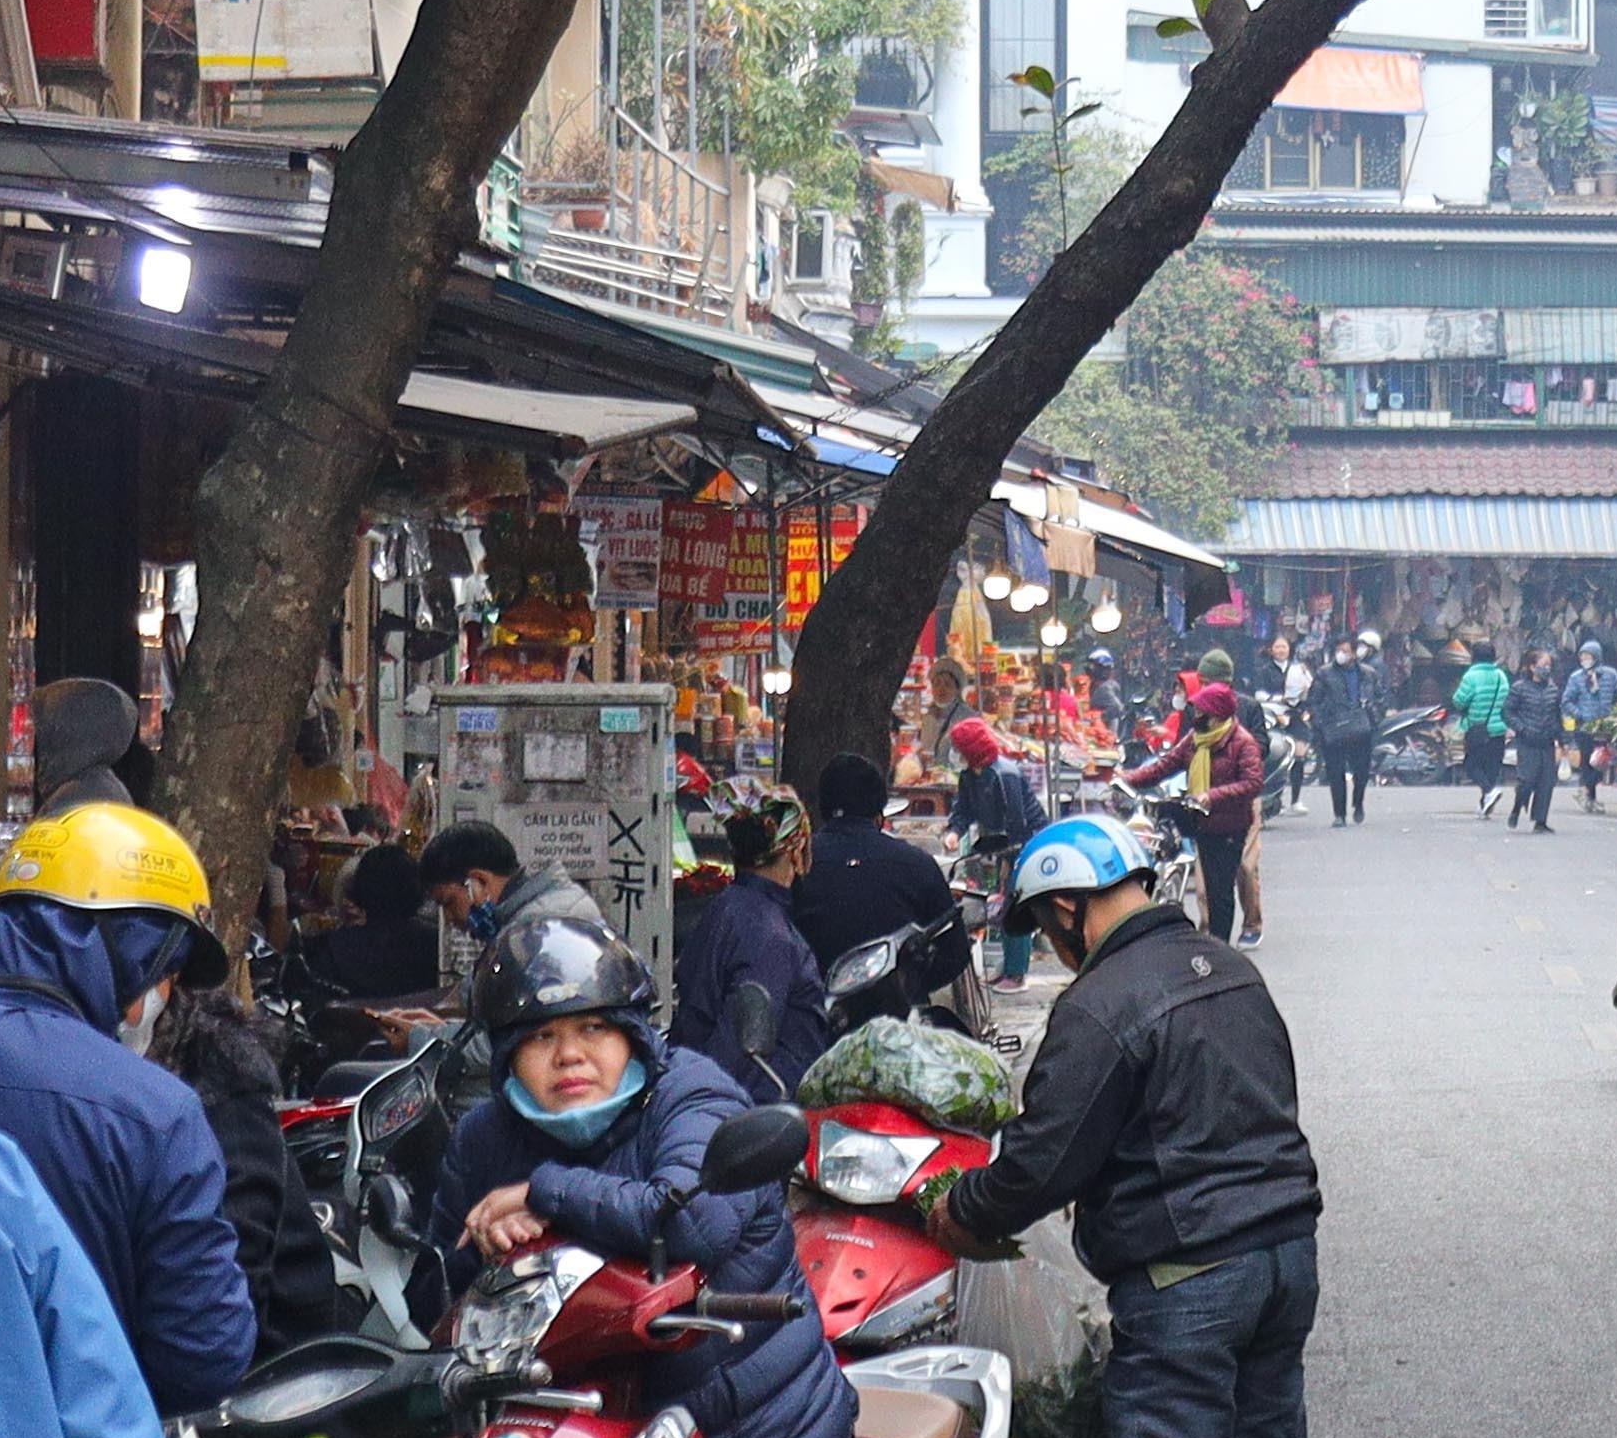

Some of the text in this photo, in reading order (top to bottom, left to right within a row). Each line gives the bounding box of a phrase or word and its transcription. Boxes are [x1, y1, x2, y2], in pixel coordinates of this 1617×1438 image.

[684, 541, 726, 569] LONG
[661, 575, 680, 595] UA
[824, 1232, 877, 1249] HONDA
